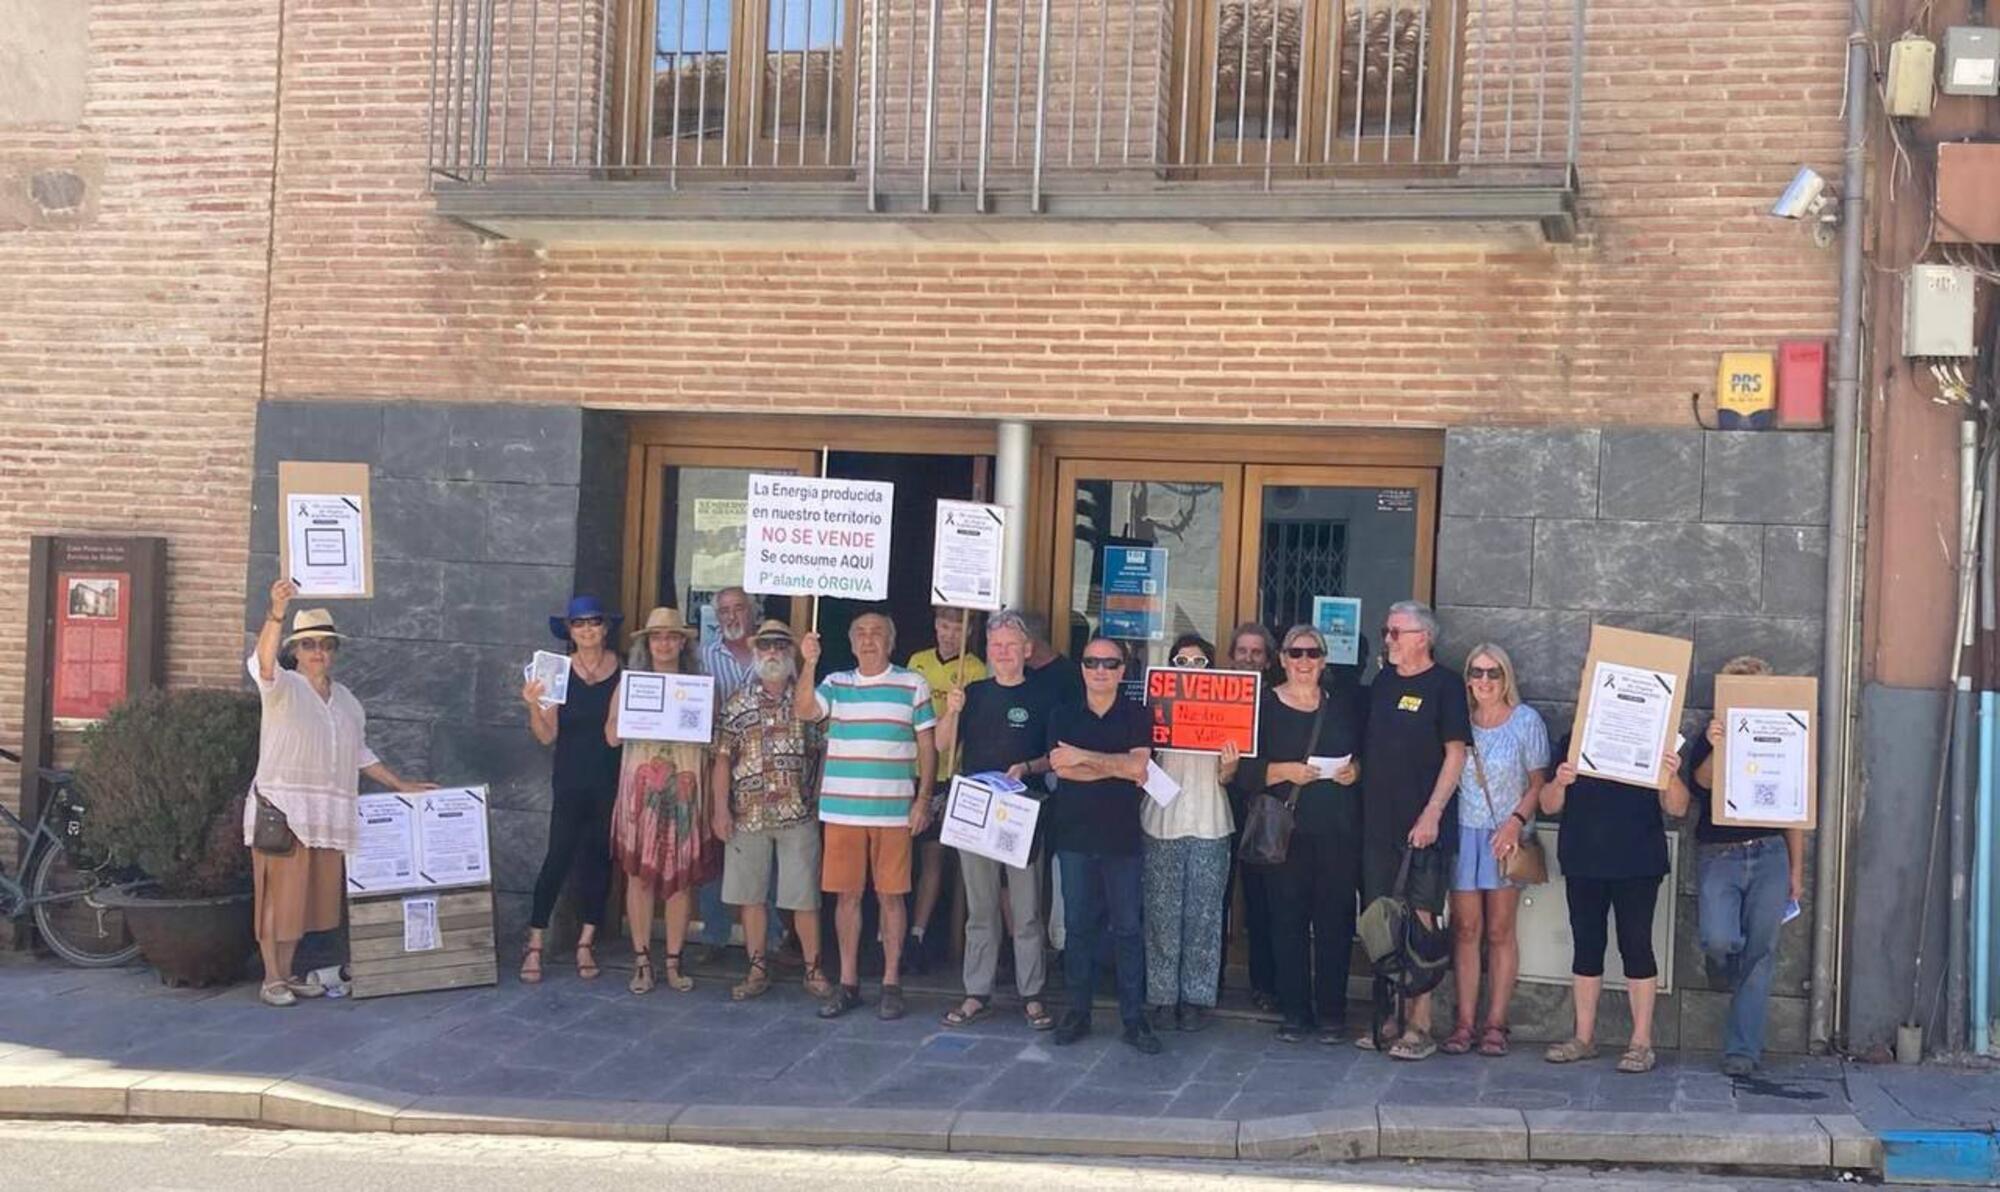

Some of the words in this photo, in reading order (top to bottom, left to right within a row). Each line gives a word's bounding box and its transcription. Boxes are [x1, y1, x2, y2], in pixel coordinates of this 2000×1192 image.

[1731, 373, 1762, 393] PRS
[754, 482, 769, 495] La
[821, 486, 882, 502] producida
[752, 507, 768, 518] en
[772, 508, 820, 521] nuestro
[824, 509, 881, 525] territorio
[762, 527, 786, 543] NO
[792, 528, 812, 544] SE
[818, 530, 874, 548] VENDE
[761, 549, 777, 563] Se
[780, 552, 837, 567] consume
[840, 552, 873, 569] AQUÍ
[818, 573, 872, 592] ÓRGIVA
[1150, 672, 1177, 698] SE
[1182, 673, 1255, 702] VENDE
